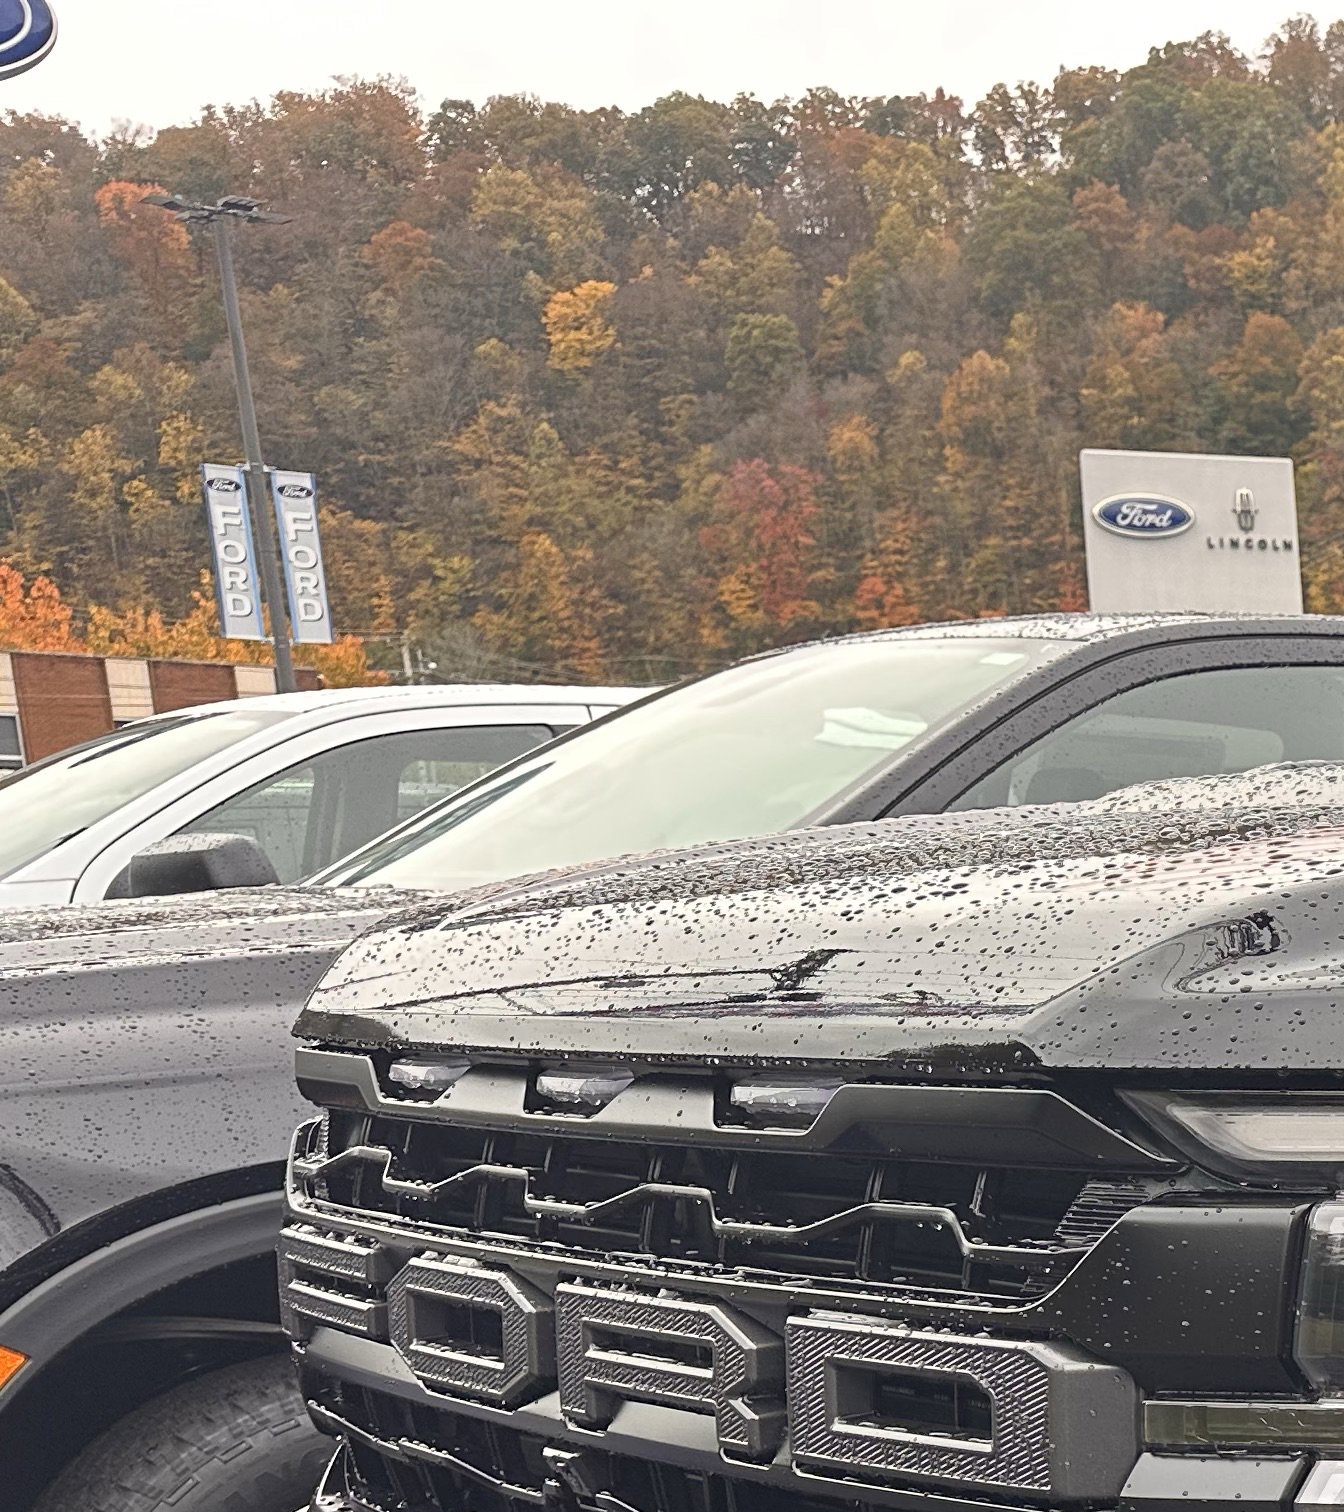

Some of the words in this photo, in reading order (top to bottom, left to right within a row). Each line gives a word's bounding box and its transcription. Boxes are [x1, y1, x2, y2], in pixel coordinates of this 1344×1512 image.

[211, 478, 238, 492] Ford
[282, 484, 308, 499] Ford
[1116, 501, 1173, 528] Ford
[1206, 536, 1293, 552] LINCOLN
[212, 504, 253, 618] FORD
[284, 511, 324, 622] FORD
